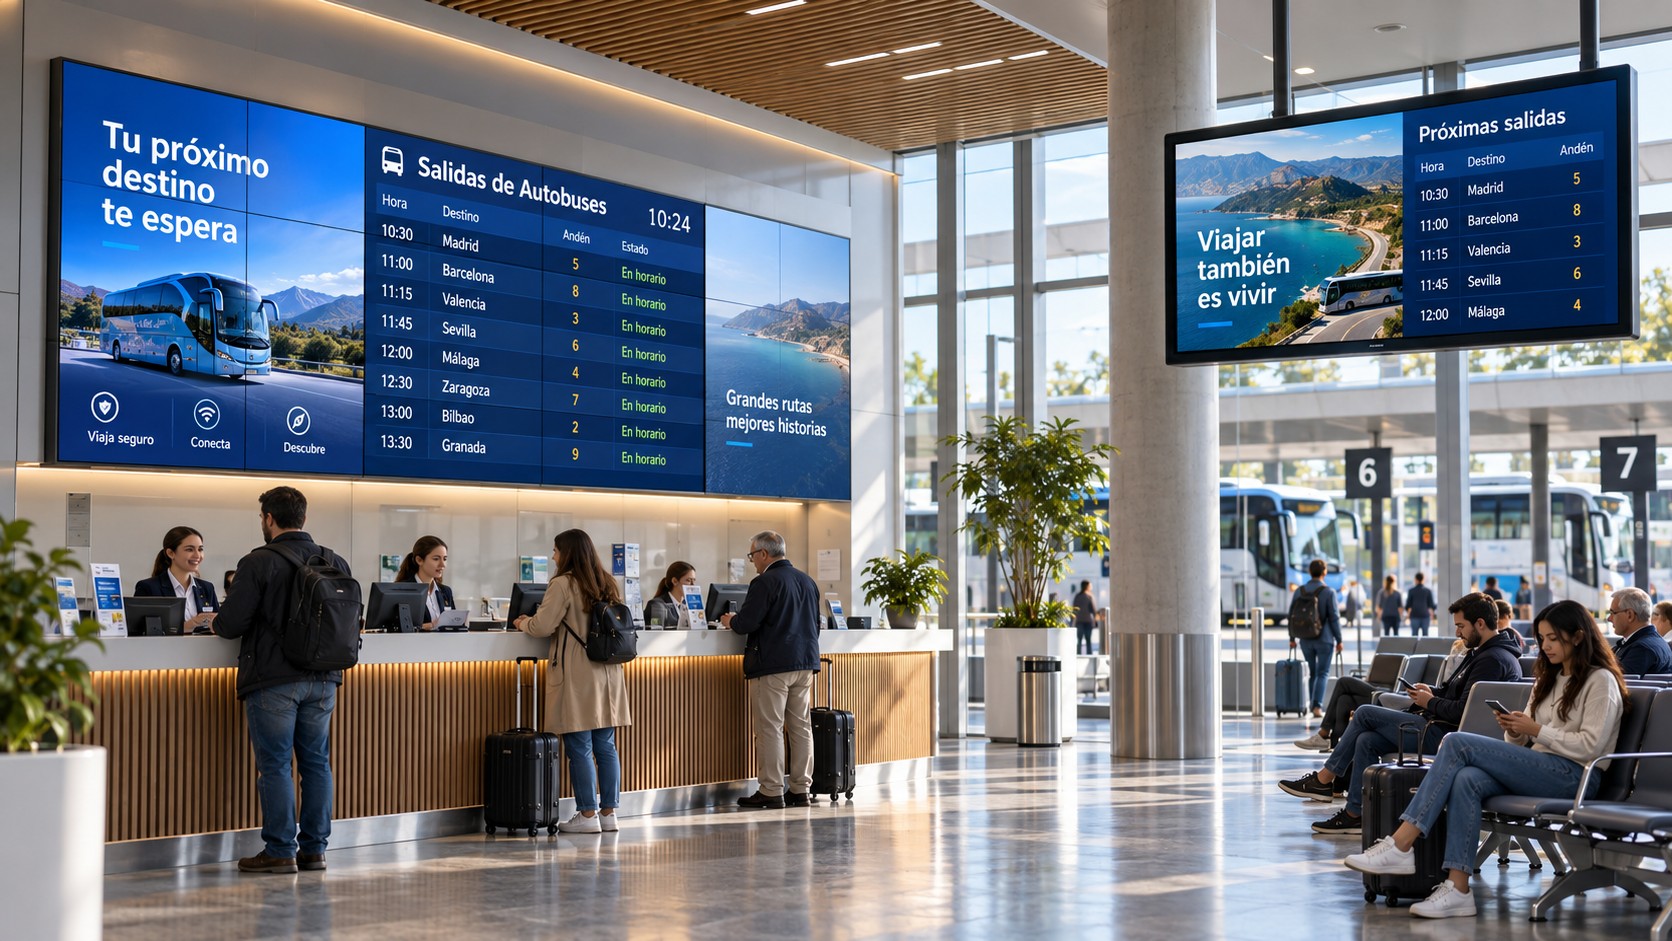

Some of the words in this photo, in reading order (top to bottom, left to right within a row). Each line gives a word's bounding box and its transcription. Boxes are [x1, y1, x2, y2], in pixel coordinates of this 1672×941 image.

[1420, 121, 1498, 142] Próximas
[1505, 109, 1565, 131] salidas
[103, 120, 140, 154] Tu
[151, 138, 269, 179] próximo
[1421, 163, 1444, 172] Hora
[1468, 154, 1505, 167] Destino
[1560, 142, 1593, 155] Andén
[102, 160, 215, 204] destino
[419, 156, 486, 189] Salidas
[492, 173, 514, 195] de
[519, 180, 606, 214] Autobuses
[1421, 188, 1448, 201] 10:30
[1468, 181, 1503, 195] Madrid
[1573, 172, 1580, 184] 5
[102, 199, 133, 227] te
[143, 211, 237, 244] espera
[383, 194, 407, 209] Hora
[443, 206, 479, 222] Destino
[563, 230, 590, 243] Andén
[622, 241, 648, 255] Estado
[649, 208, 690, 232] 10:24
[1421, 218, 1448, 231] 11:00
[1468, 212, 1518, 226] Barcelona
[1573, 204, 1580, 216] 8
[382, 224, 413, 240] 10:30
[443, 234, 478, 252] Madrid
[572, 258, 578, 270] 5
[622, 266, 632, 279] En
[636, 269, 666, 285] horario
[1198, 227, 1265, 254] Viajar
[1421, 248, 1448, 261] 11:15
[1468, 243, 1510, 256] Valencia
[1573, 235, 1580, 247] 3
[1198, 253, 1289, 280] también
[1421, 278, 1448, 291] 11:45
[1468, 274, 1500, 287] Sevilla
[1573, 267, 1581, 279] 6
[382, 254, 413, 270] 11:00
[443, 264, 494, 283] Barcelona
[572, 285, 579, 297] 8
[622, 293, 632, 305] En
[636, 295, 666, 310] horario
[1198, 292, 1221, 308] es
[1228, 282, 1276, 306] vivir
[382, 284, 412, 300] 11:15
[443, 292, 485, 310] Valencia
[572, 312, 578, 324] 3
[622, 320, 632, 331] En
[636, 321, 666, 336] horario
[1421, 308, 1448, 321] 12:00
[1469, 306, 1504, 319] Málaga
[1573, 299, 1581, 310] 4
[382, 314, 412, 330] 11:45
[443, 322, 476, 338] Sevilla
[572, 339, 579, 351] 6
[622, 346, 632, 358] En
[636, 348, 666, 362] horario
[382, 345, 412, 359] 12:00
[443, 351, 479, 369] Málaga
[572, 367, 579, 378] 4
[622, 372, 632, 384] En
[636, 374, 666, 388] horario
[382, 374, 412, 389] 12:30
[442, 380, 489, 398] Zaragoza
[572, 394, 578, 405] 7
[622, 399, 632, 410] En
[636, 400, 666, 414] horario
[727, 389, 778, 410] Grandes
[783, 399, 812, 413] rutas
[382, 405, 412, 419] 13:00
[443, 410, 474, 424] Bilbao
[572, 421, 578, 433] 2
[622, 425, 632, 437] En
[636, 426, 666, 439] horario
[727, 414, 775, 433] mejores
[779, 418, 826, 436] historias
[88, 431, 114, 445] Viaja
[118, 435, 154, 447] seguro
[191, 437, 230, 449] Conecta
[284, 442, 325, 454] Descubre
[382, 435, 412, 449] 13:30
[442, 439, 485, 453] Granada
[572, 448, 578, 460] 9
[622, 452, 632, 463] En
[636, 453, 666, 465] horario
[1359, 458, 1377, 487] 6
[1617, 447, 1637, 478] 7
